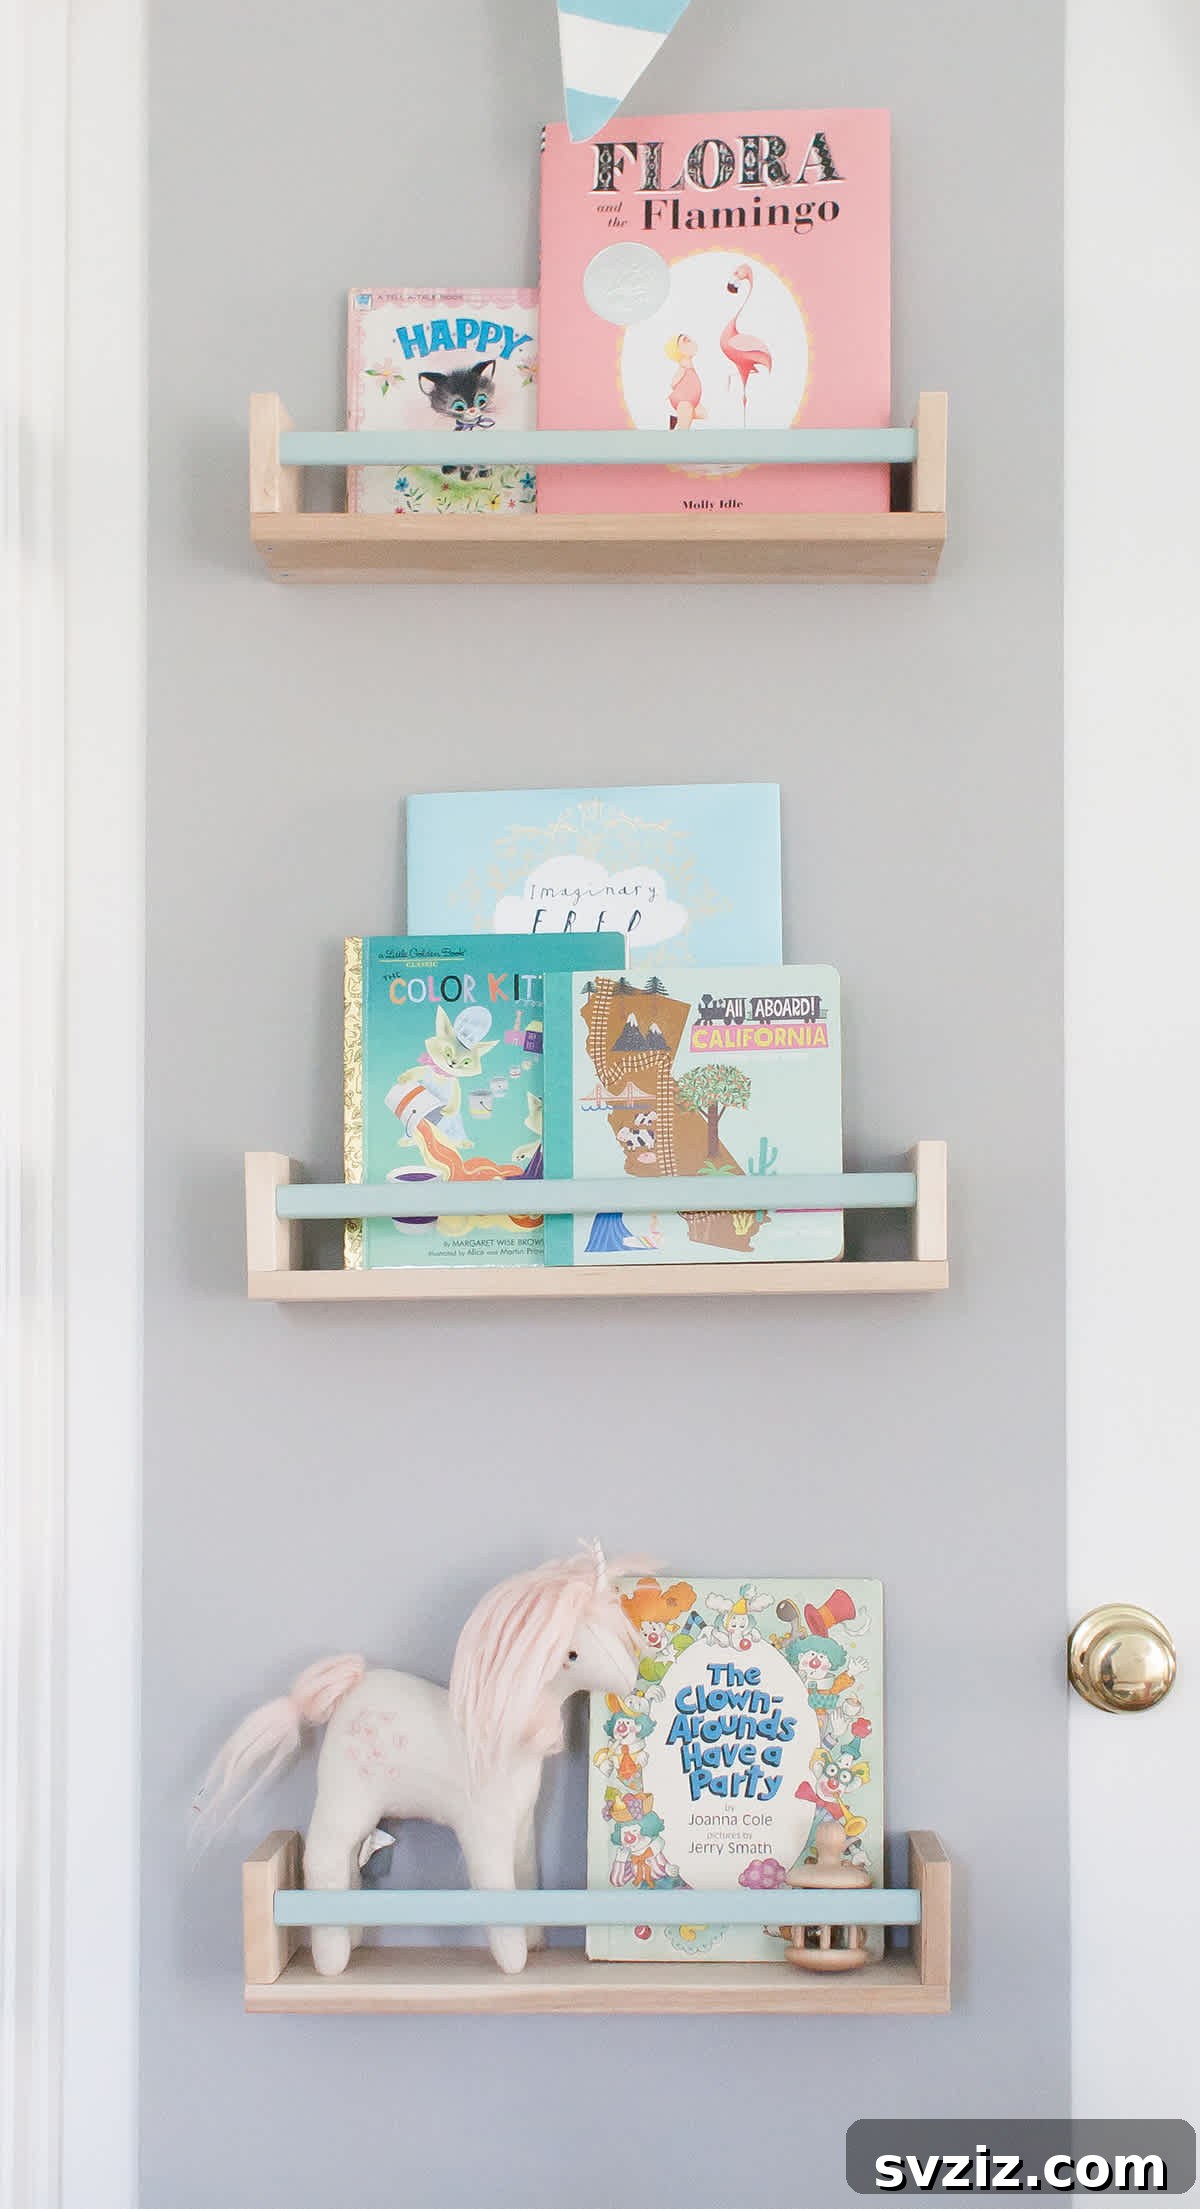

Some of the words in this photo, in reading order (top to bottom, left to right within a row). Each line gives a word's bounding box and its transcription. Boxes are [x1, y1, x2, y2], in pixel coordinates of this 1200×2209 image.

[589, 131, 846, 194] FLORA
[596, 202, 622, 213] and
[640, 196, 840, 235] Flamingo
[607, 217, 627, 228] the
[396, 318, 533, 361] HAPPY
[681, 500, 714, 510] Molly
[719, 499, 744, 509] Idle
[530, 884, 657, 906] Imaginary
[383, 972, 401, 981] THE
[389, 973, 476, 1005] COLOR
[487, 973, 543, 1002] KIT
[755, 999, 816, 1017] ABOARD!
[692, 1028, 826, 1049] CALIFORNIA
[452, 1240, 494, 1248] MARGARET
[706, 1663, 761, 1687] The
[675, 1685, 784, 1714] Clown-
[666, 1710, 798, 1745] Arounds
[681, 1743, 757, 1773] Have
[761, 1748, 782, 1767] a
[689, 1765, 783, 1801] Party
[688, 1813, 738, 1826] Joanna
[742, 1813, 773, 1826] Cole
[706, 1831, 740, 1840] pictures
[688, 1841, 724, 1855] Jerry
[728, 1841, 772, 1854] Smath
